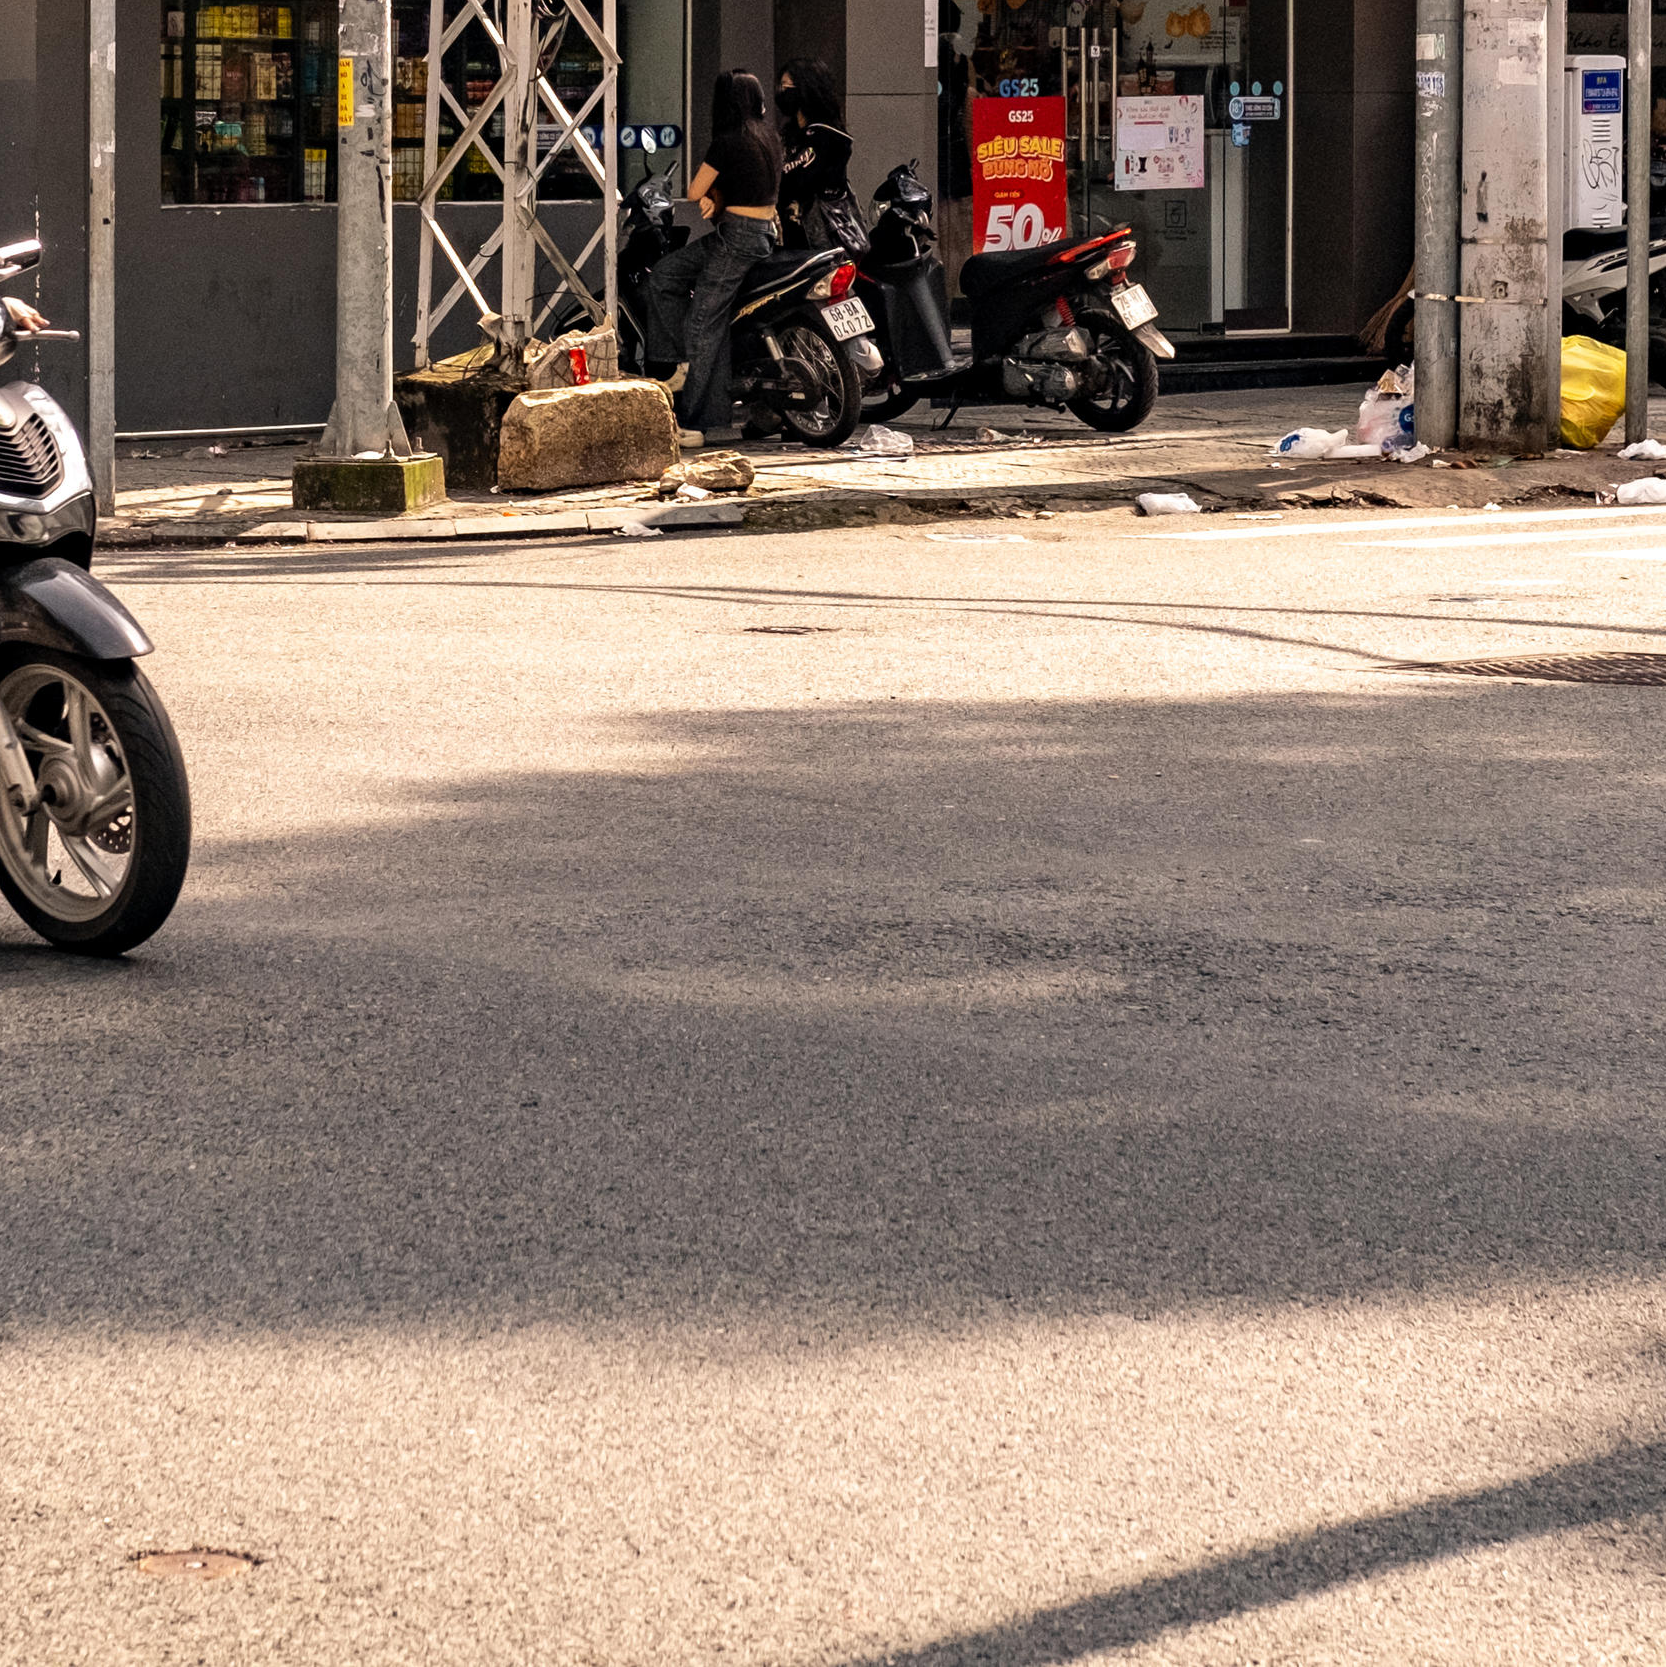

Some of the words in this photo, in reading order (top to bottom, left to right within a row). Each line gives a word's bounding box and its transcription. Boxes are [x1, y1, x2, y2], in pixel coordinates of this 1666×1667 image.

[999, 77, 1040, 97] GS25
[1007, 109, 1035, 124] GS25
[976, 134, 1017, 162] SIÊU
[1018, 135, 1065, 162] SALE
